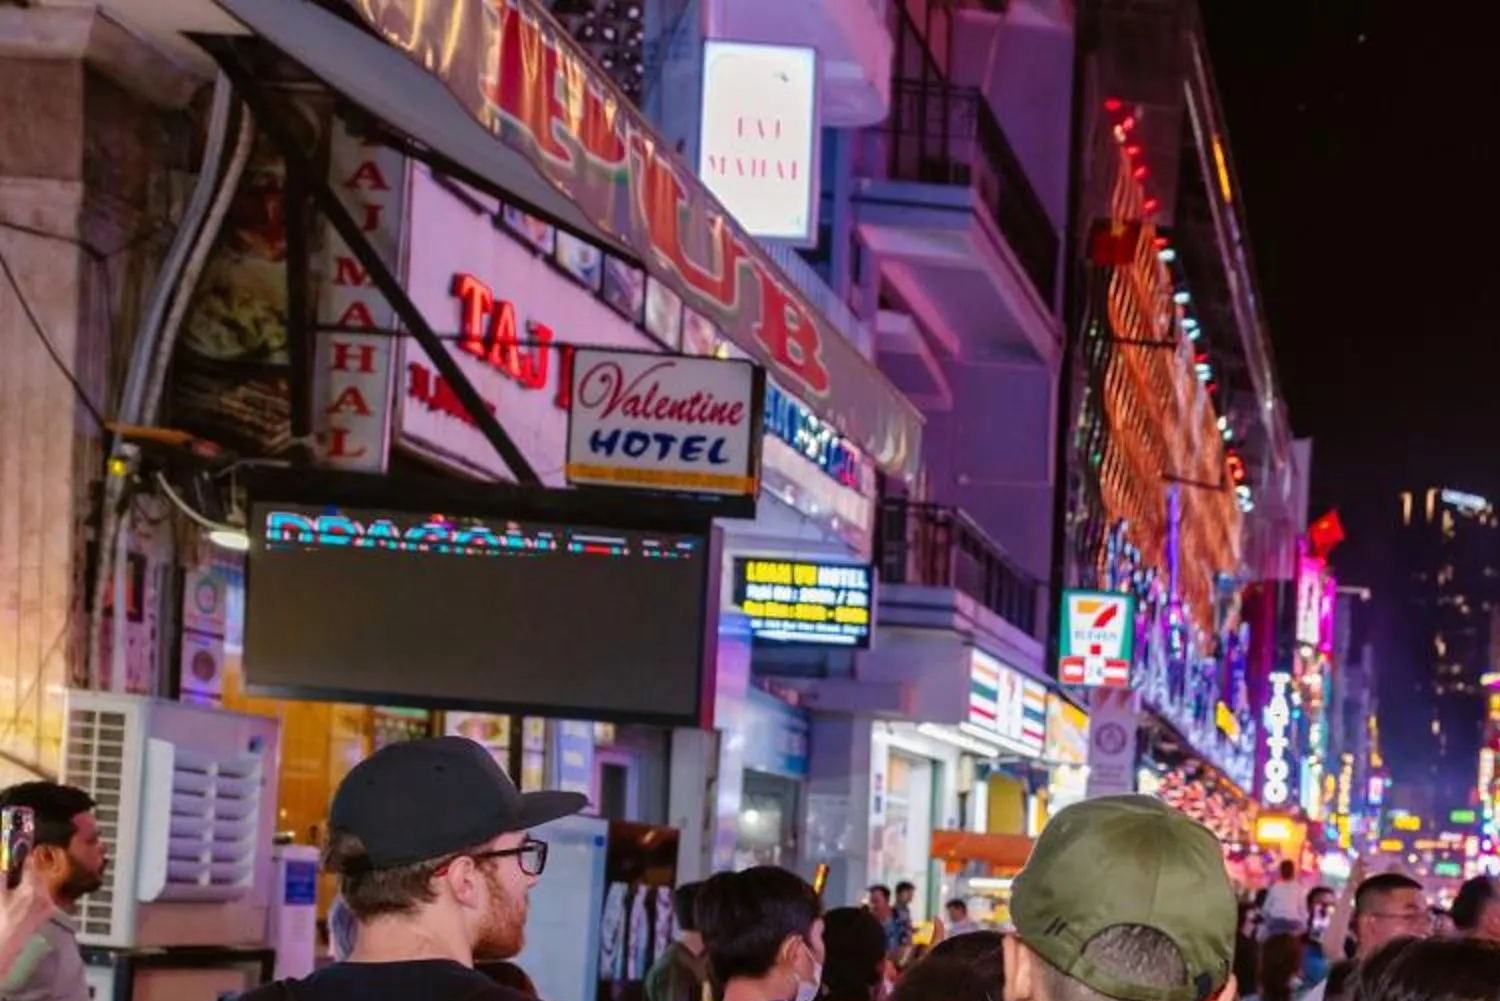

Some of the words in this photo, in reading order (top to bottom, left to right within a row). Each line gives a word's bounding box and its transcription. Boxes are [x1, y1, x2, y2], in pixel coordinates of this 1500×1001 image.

[345, 136, 390, 231] AJ
[451, 273, 554, 390] TAJ
[578, 360, 744, 427] Valentine
[588, 429, 731, 465] HOTEL
